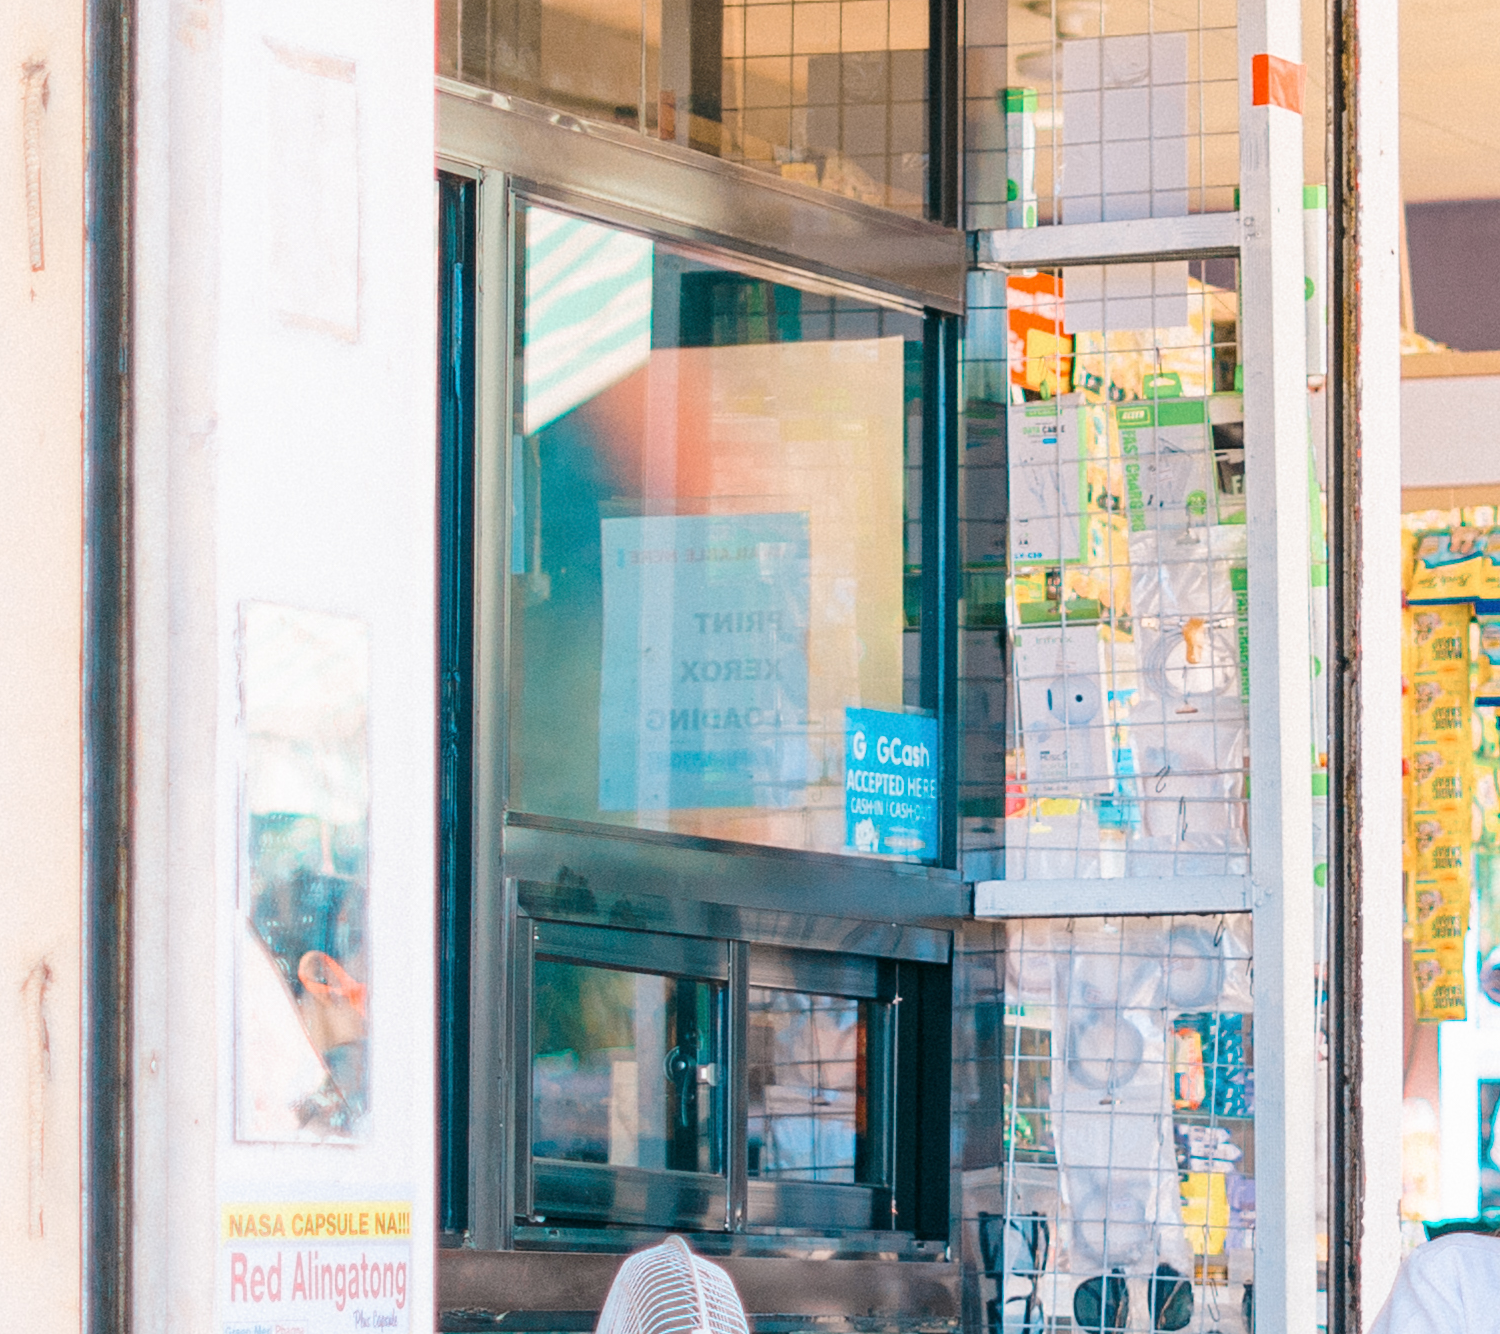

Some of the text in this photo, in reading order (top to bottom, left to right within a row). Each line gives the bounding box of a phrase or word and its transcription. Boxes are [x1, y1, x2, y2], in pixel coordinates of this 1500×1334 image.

[1042, 425, 1065, 434] CABE
[877, 735, 930, 767] GCash
[847, 769, 936, 799] ACCEPTED HERE
[228, 1211, 411, 1238] NASA CAPSULE NA!!!
[230, 1250, 407, 1312] Red Alingatong
